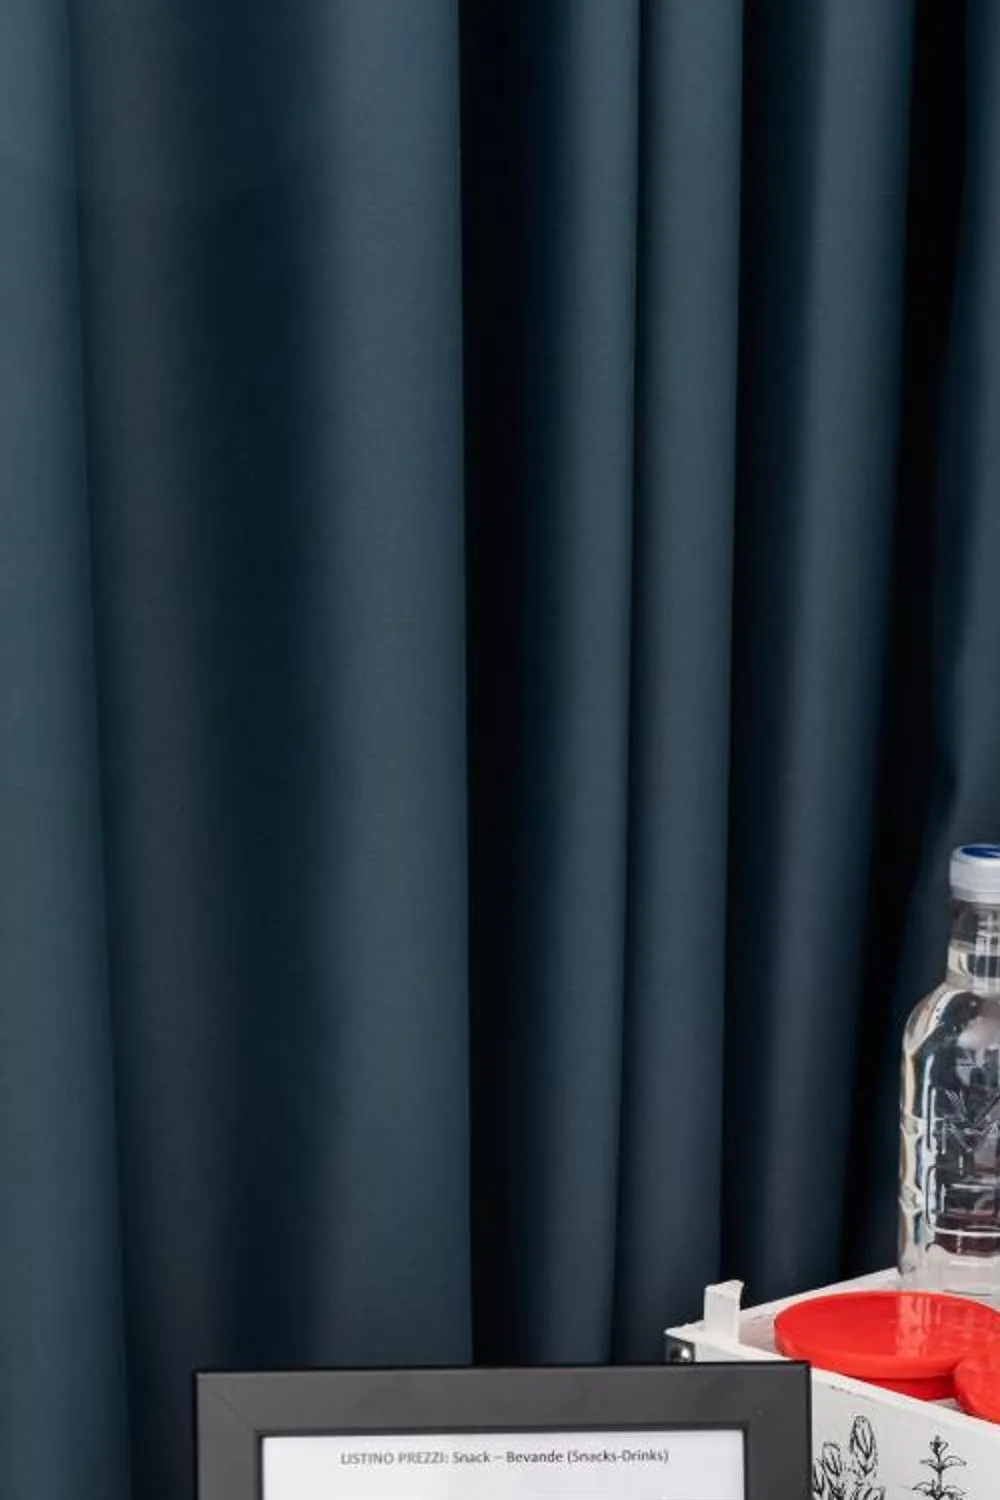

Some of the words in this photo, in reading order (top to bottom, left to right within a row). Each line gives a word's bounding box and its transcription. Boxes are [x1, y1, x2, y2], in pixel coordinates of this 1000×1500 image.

[341, 1452, 395, 1465] LISTINO
[398, 1452, 449, 1465] PREZZI:
[452, 1451, 491, 1464] Snack
[506, 1450, 563, 1463] Bevande
[567, 1449, 669, 1464] (Snacks-Drinks)
